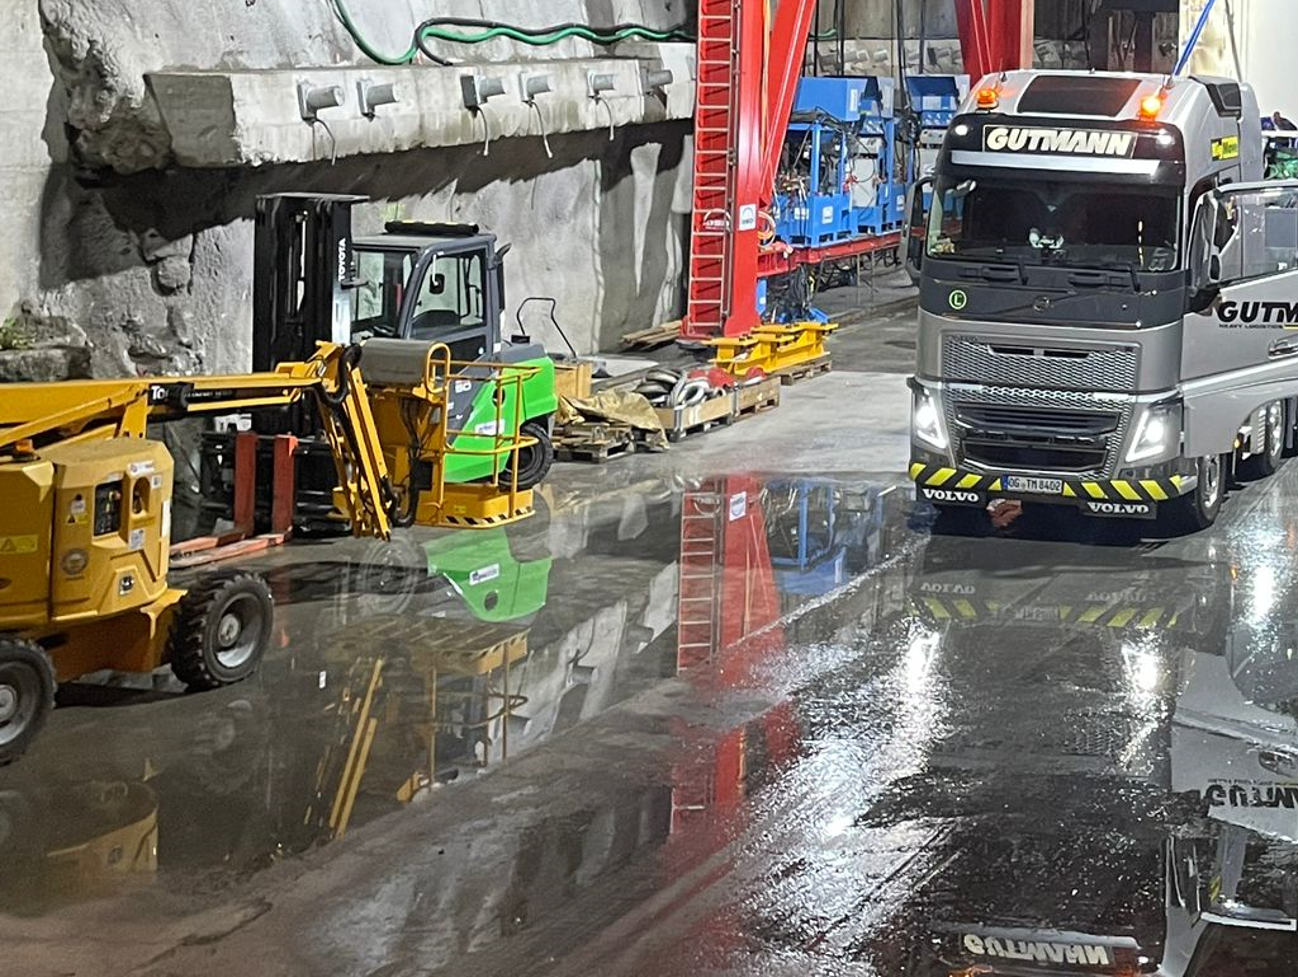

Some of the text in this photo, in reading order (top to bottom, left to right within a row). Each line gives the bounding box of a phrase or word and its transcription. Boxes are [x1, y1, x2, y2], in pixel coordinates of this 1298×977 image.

[986, 127, 1132, 155] GUTMANN
[338, 237, 346, 282] TOYOTA
[922, 488, 979, 503] VOLVO
[1086, 501, 1150, 514] VOLVO
